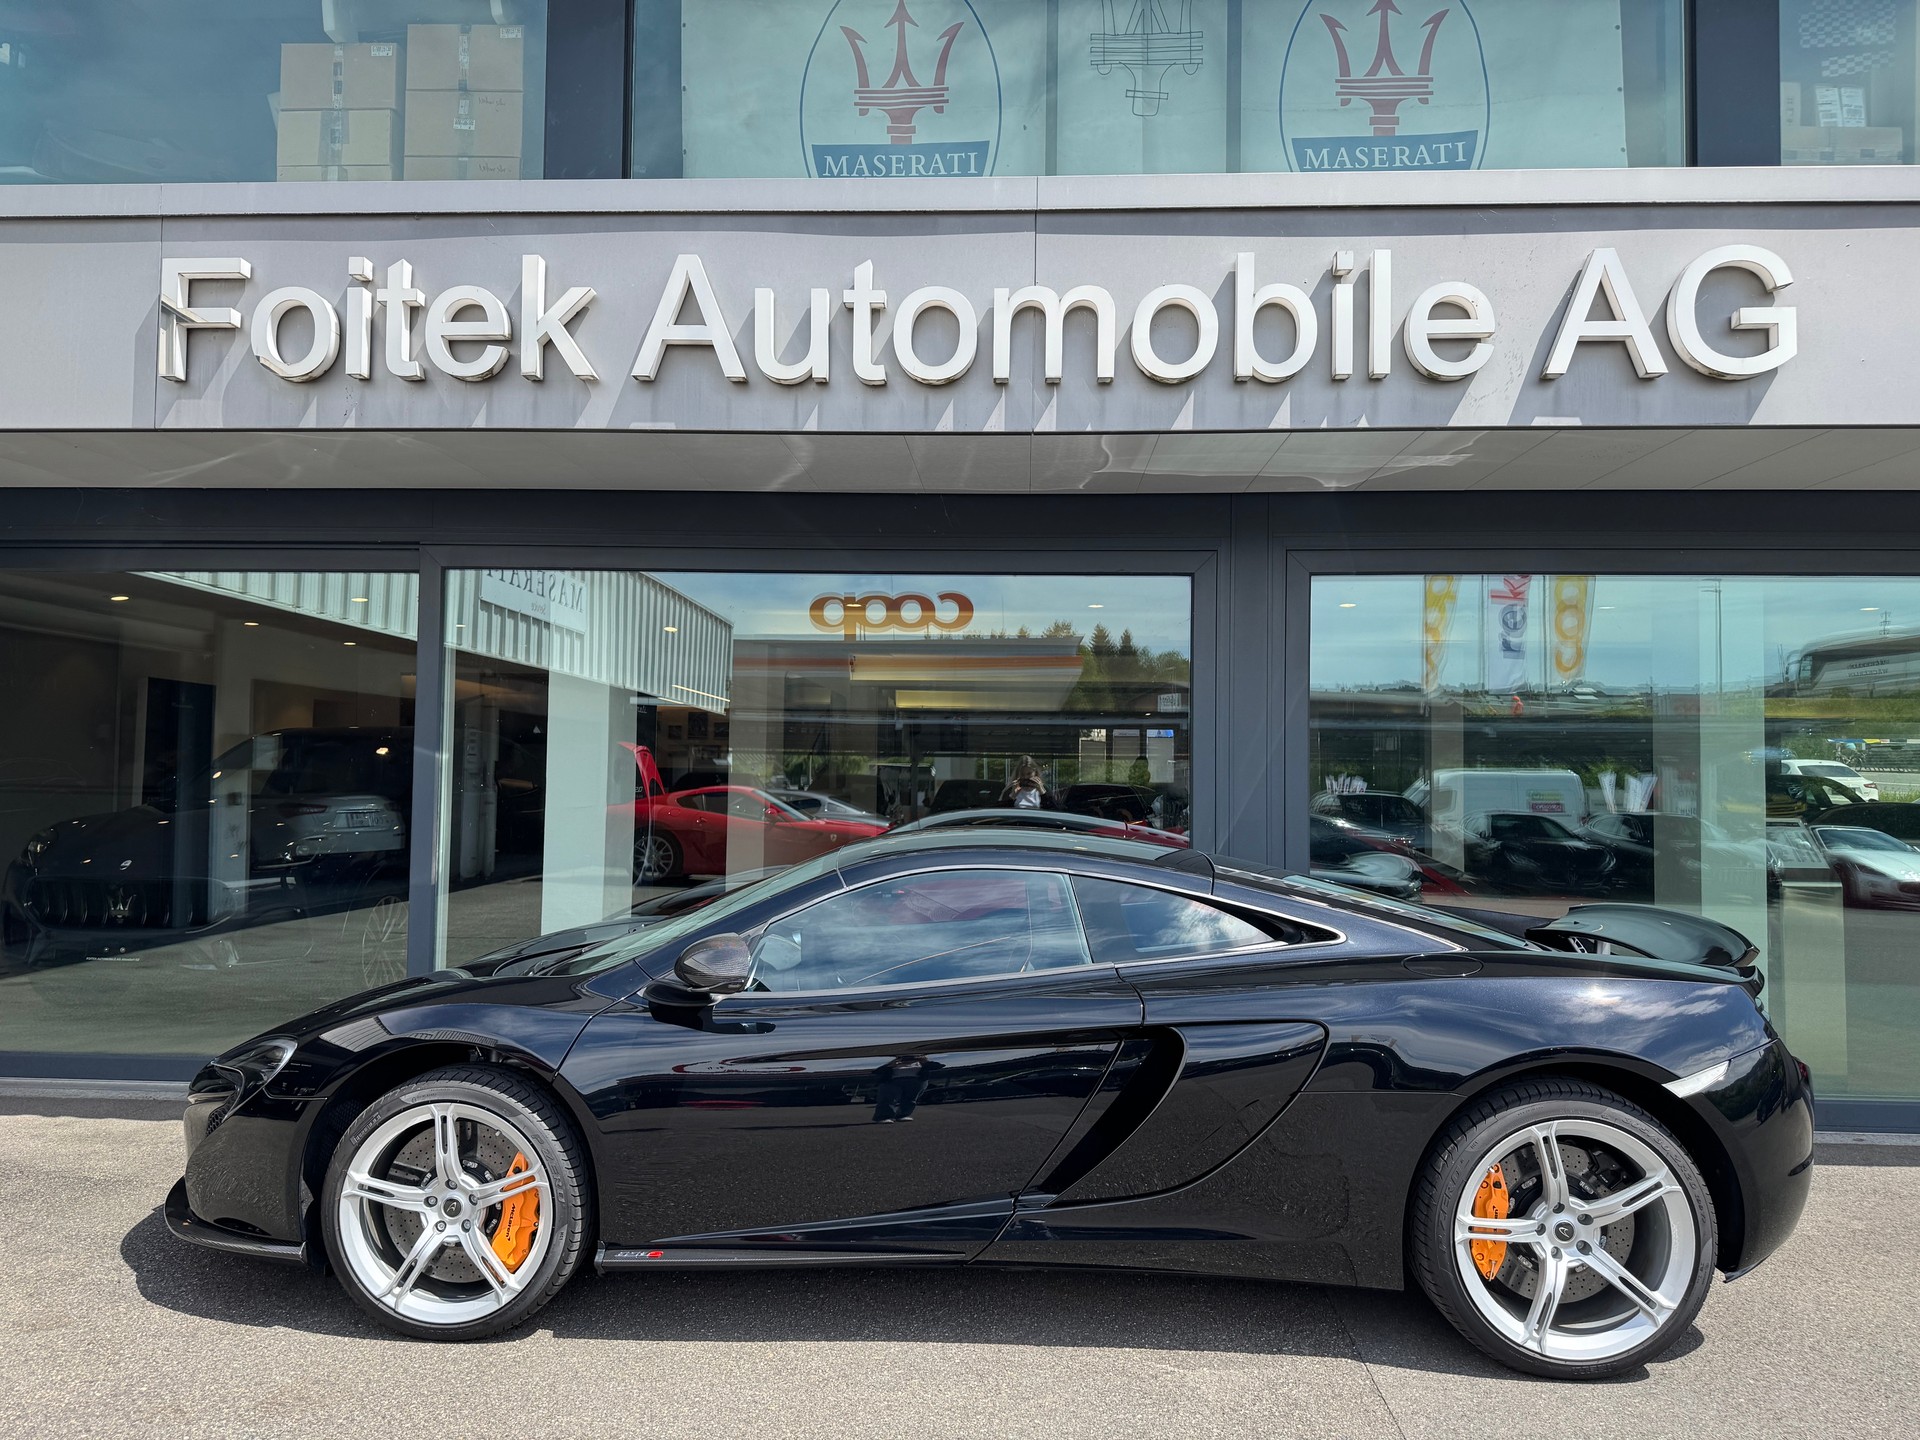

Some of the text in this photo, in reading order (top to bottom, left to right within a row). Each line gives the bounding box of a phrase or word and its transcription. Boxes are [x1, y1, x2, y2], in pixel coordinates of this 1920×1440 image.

[822, 152, 979, 178] MASERATI
[1303, 141, 1467, 170] MASERATI
[158, 244, 1798, 387] Foitek Automobile AG
[505, 1203, 516, 1238] McLaren
